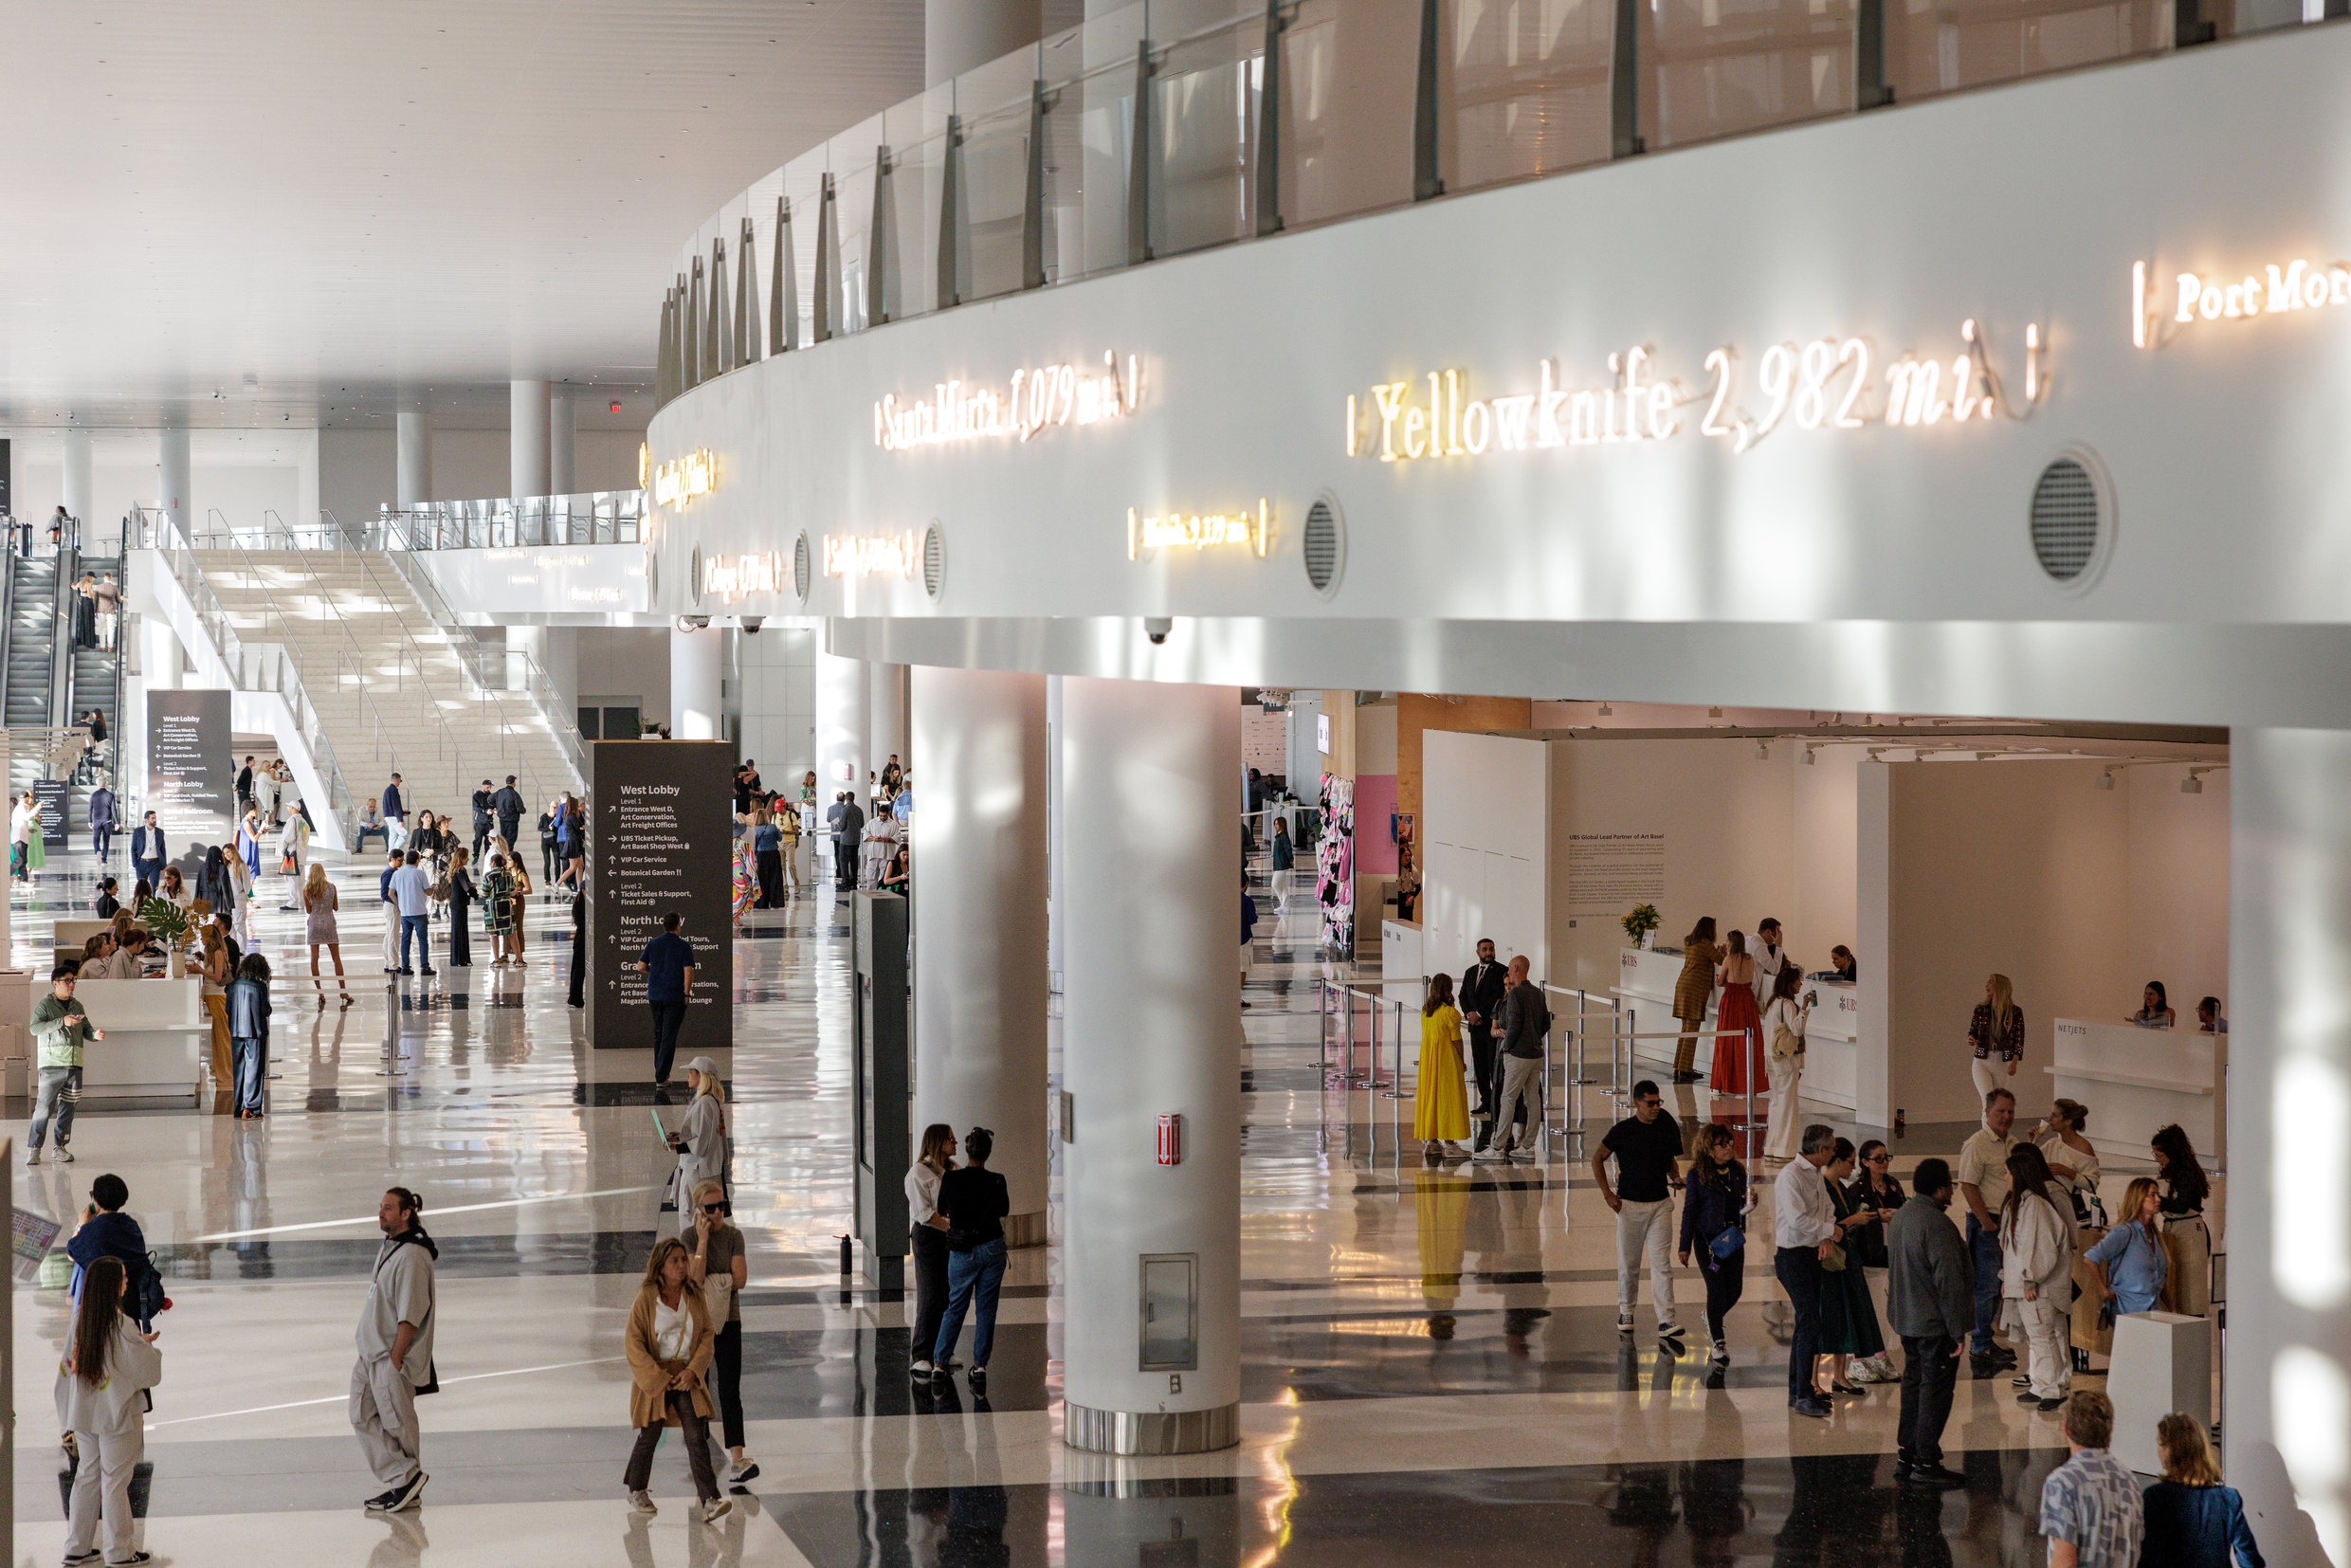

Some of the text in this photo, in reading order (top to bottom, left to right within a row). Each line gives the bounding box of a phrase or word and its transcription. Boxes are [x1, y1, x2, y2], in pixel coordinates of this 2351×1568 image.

[2175, 259, 2351, 323] Port Mor
[1371, 344, 1678, 462] Yellowknife
[1704, 337, 1871, 454] 2,982
[621, 785, 680, 796] West Lobby
[621, 916, 685, 926] North Loy
[621, 962, 638, 970] Gra
[1627, 955, 1637, 967] UBS
[2058, 1025, 2086, 1035] NETJETS
